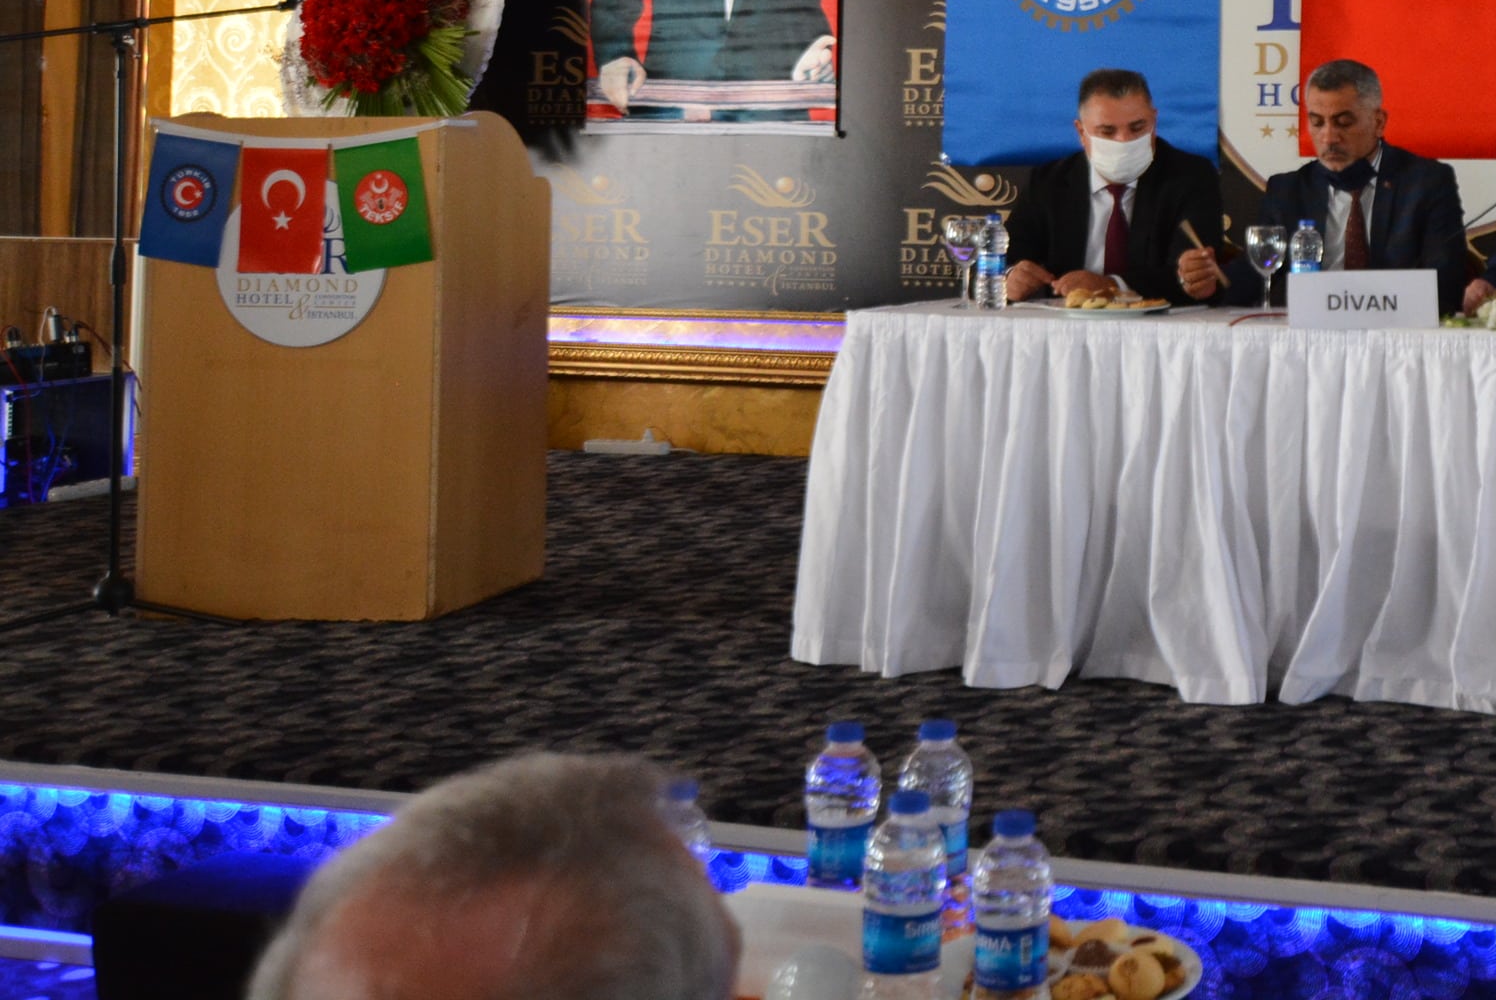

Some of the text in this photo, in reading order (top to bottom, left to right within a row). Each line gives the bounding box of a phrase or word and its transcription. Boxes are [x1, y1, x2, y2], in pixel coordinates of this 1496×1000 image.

[705, 209, 838, 248] ESER
[704, 248, 838, 266] DIAMOND
[704, 263, 767, 276] HOTEL
[236, 278, 359, 293] DIAMOND
[236, 293, 294, 306] HOTEL
[1327, 290, 1399, 312] DİVAN
